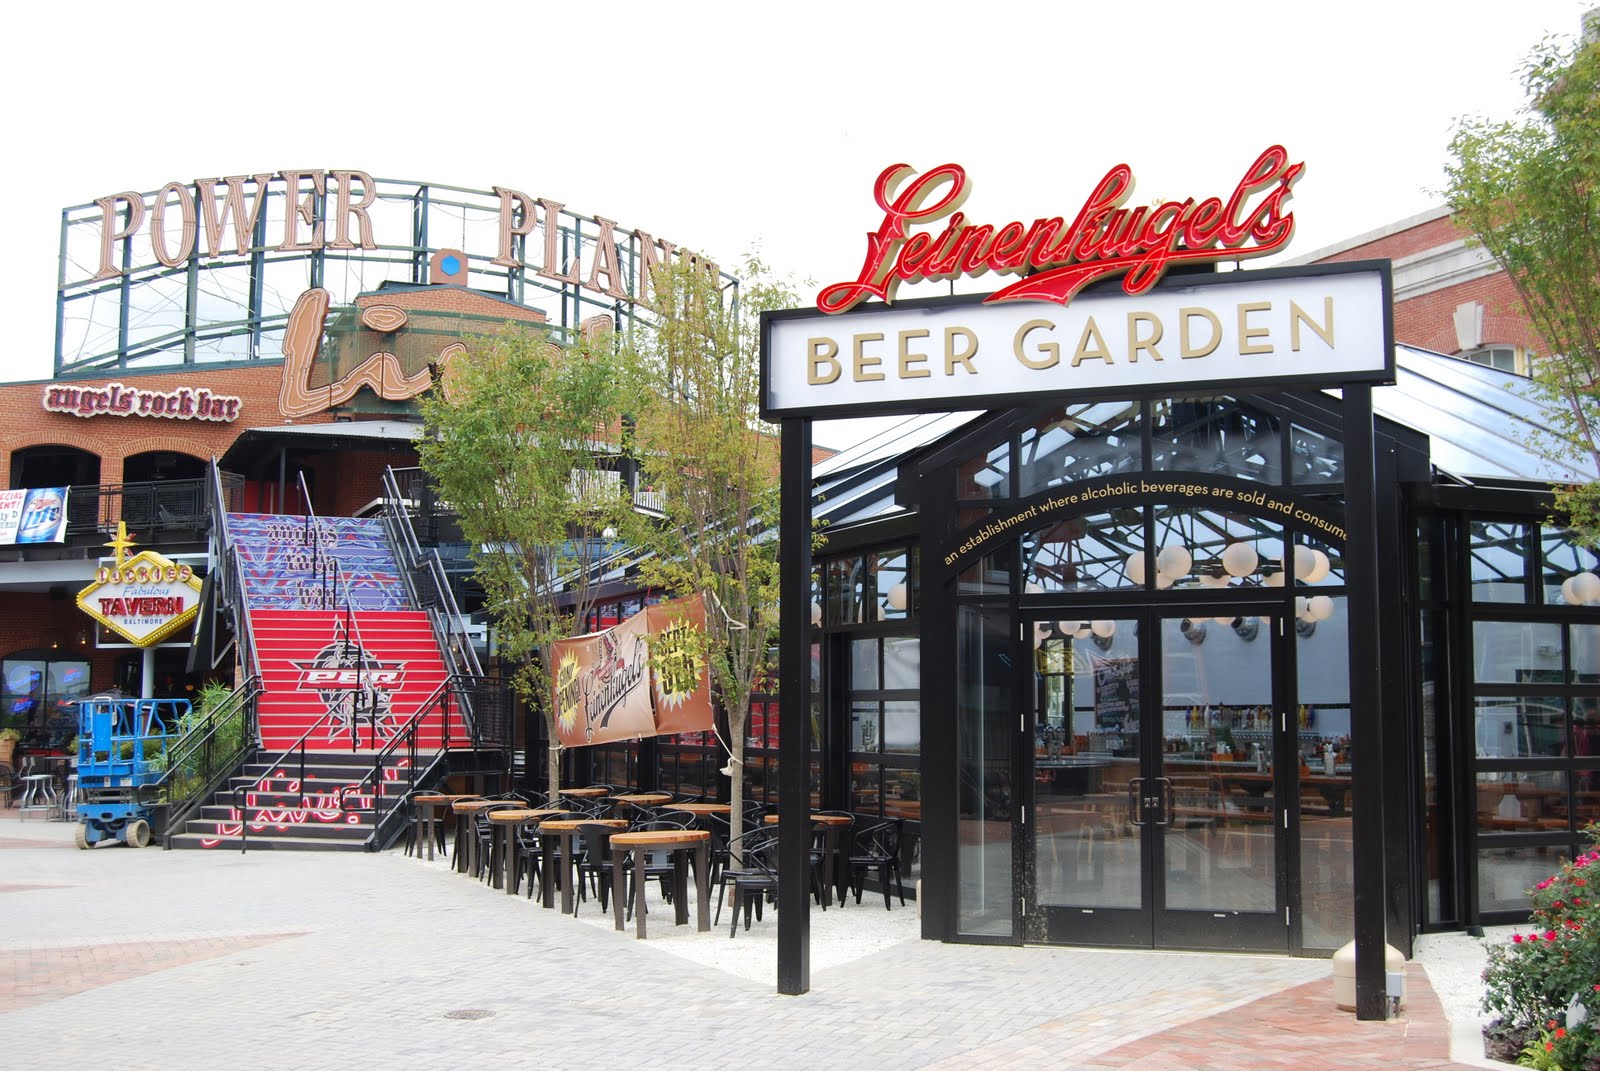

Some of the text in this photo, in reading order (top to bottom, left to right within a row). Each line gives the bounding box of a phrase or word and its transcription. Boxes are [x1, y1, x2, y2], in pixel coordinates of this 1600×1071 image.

[93, 169, 377, 281] POWER
[816, 144, 1305, 314] Leinenkugel's
[806, 296, 1336, 386] BEER GARDEN
[138, 390, 194, 416] rock
[197, 391, 240, 420] bar
[944, 550, 959, 566] an
[959, 505, 1038, 554] establishment
[1039, 498, 1079, 513] where
[1081, 481, 1138, 501] alcoholic
[1141, 480, 1209, 496] beverages
[1211, 484, 1234, 498] are
[1236, 490, 1266, 506] sold
[1267, 498, 1295, 515] and
[98, 565, 192, 583] LUCKIES
[98, 596, 184, 616] TAVERN
[122, 585, 172, 597] Fabulous
[306, 671, 399, 684] PBR
